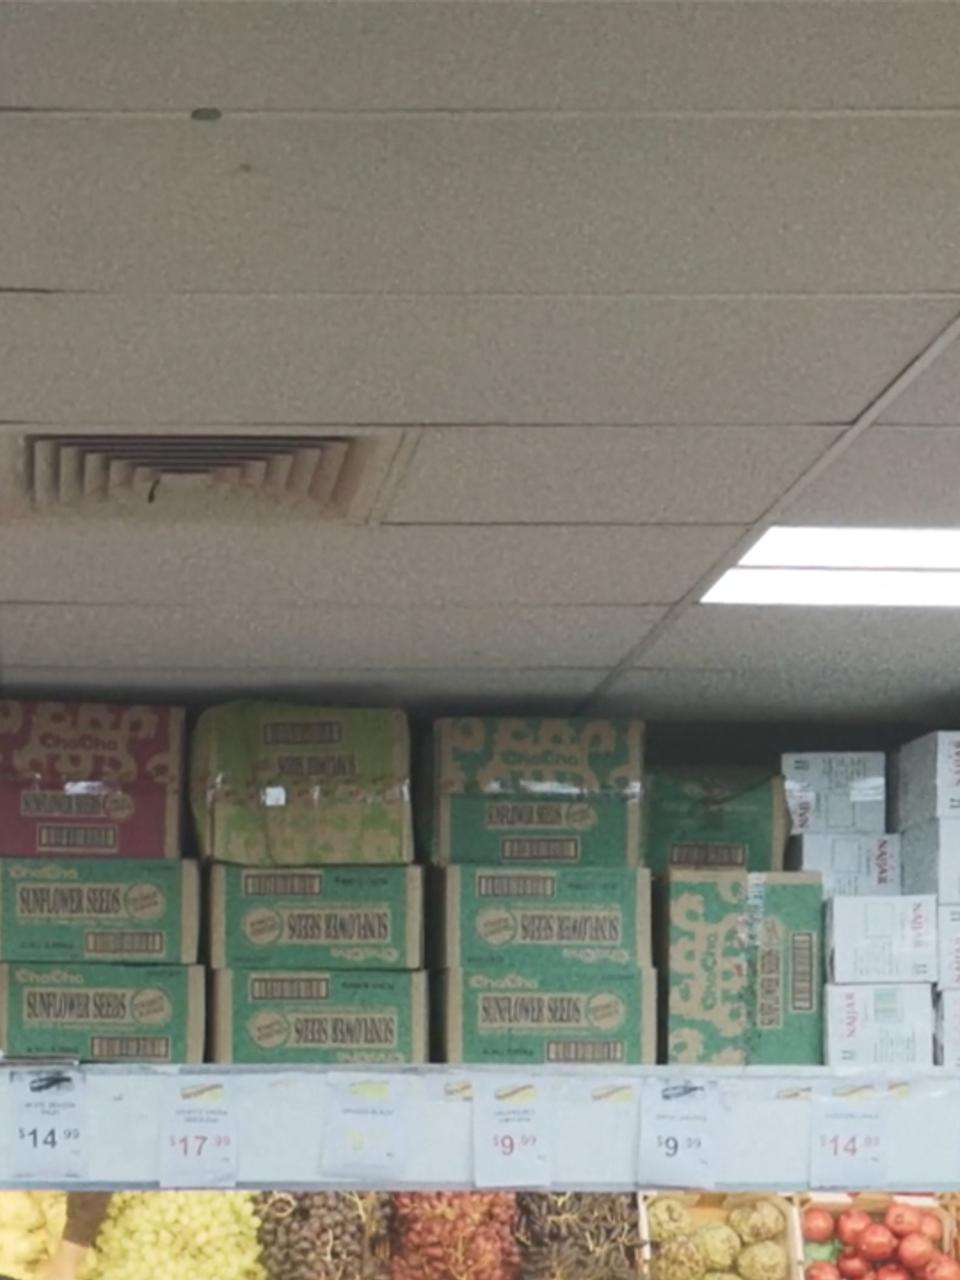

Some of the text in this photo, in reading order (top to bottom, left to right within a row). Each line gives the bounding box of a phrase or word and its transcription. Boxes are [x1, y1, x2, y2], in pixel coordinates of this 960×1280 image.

[19, 886, 121, 915] SUNFLOWER SEEDS
[26, 991, 127, 1020] SUNFLOWER SEEDS
[481, 995, 582, 1023] SUNFLOWER SEEDS
